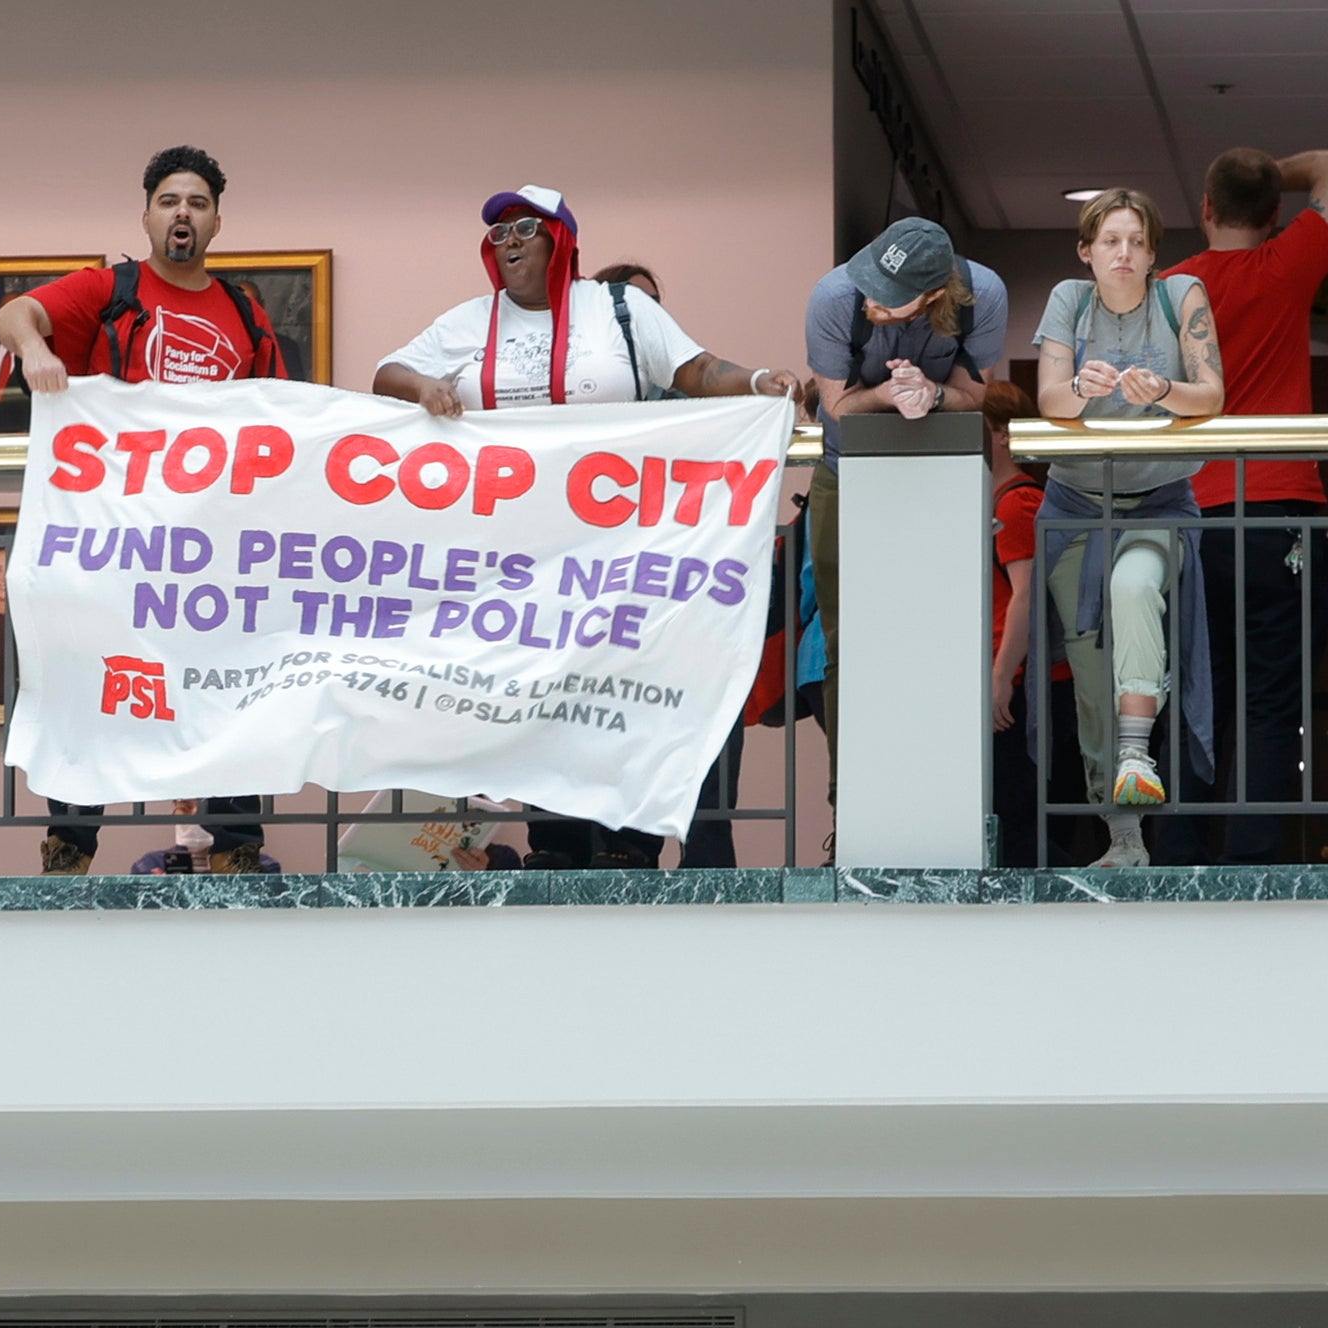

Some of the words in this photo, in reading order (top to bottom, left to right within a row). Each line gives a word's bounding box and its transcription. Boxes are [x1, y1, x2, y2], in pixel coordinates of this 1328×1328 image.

[163, 369, 213, 384] Liberati
[164, 357, 208, 376] Socialism
[210, 364, 219, 376] &
[165, 345, 189, 363] Party
[191, 350, 206, 363] for
[49, 423, 294, 496] STOP
[325, 433, 535, 516] COP
[566, 451, 778, 528] CITY
[38, 524, 213, 574] FUND
[238, 529, 535, 591] PEOPLE'S
[558, 551, 749, 606] NEEDS
[133, 582, 269, 634] NOT
[292, 589, 412, 639] THE
[430, 599, 647, 650] POLICE
[100, 670, 176, 722] PSL
[182, 661, 274, 690] PARTY
[279, 651, 332, 672] FOR
[339, 652, 495, 693] SOCIALISM
[504, 679, 521, 698] &
[234, 669, 408, 712] 470-509-4746
